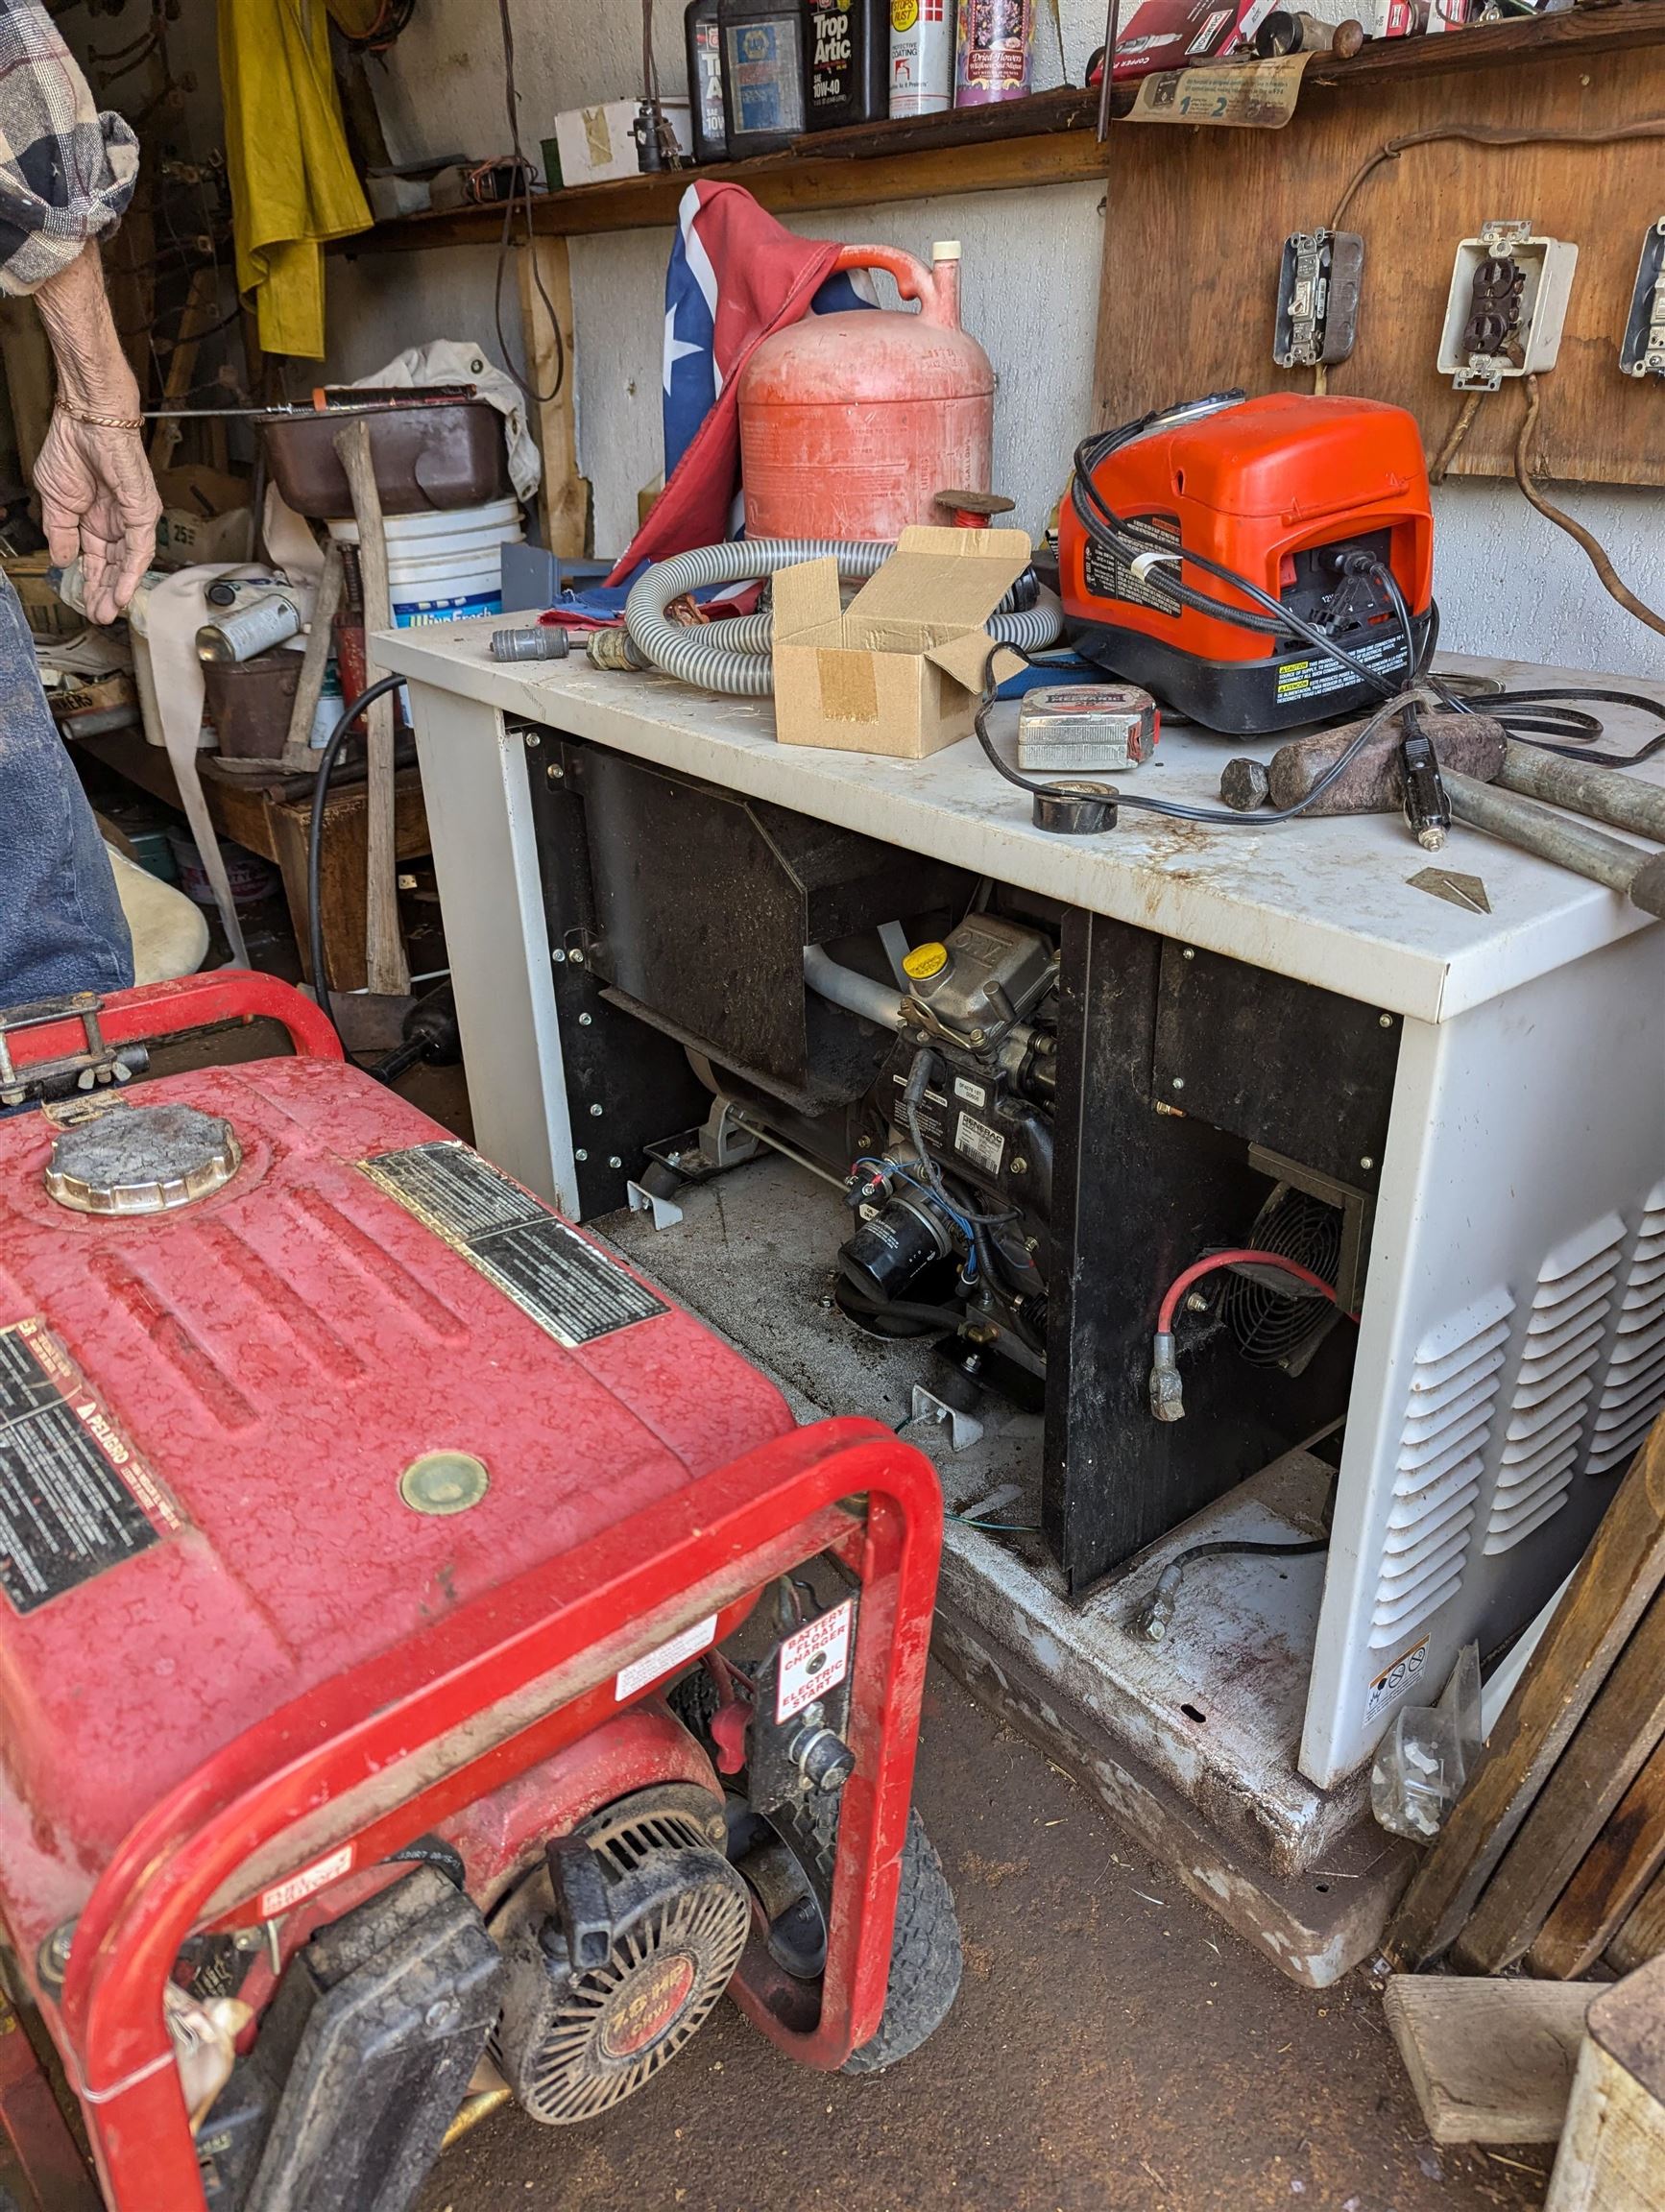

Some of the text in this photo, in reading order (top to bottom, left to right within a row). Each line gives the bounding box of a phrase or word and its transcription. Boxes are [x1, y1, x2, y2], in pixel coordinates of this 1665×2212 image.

[813, 14, 848, 39] Trop
[814, 37, 851, 64] Artic
[973, 51, 1022, 63] Dried Flowers
[1121, 57, 1149, 68] COPPER
[813, 79, 840, 98] 10W-40
[1180, 96, 1191, 114] 1
[1211, 97, 1227, 116] 2
[962, 1116, 1002, 1142] GENERAC
[86, 1413, 129, 1464] PELIGRO
[788, 1606, 845, 1649] BATTERY
[797, 1622, 835, 1654] FLOAT
[784, 1624, 846, 1671] CHARGER
[783, 1660, 843, 1706] ELECTRIC
[792, 1676, 832, 1708] START
